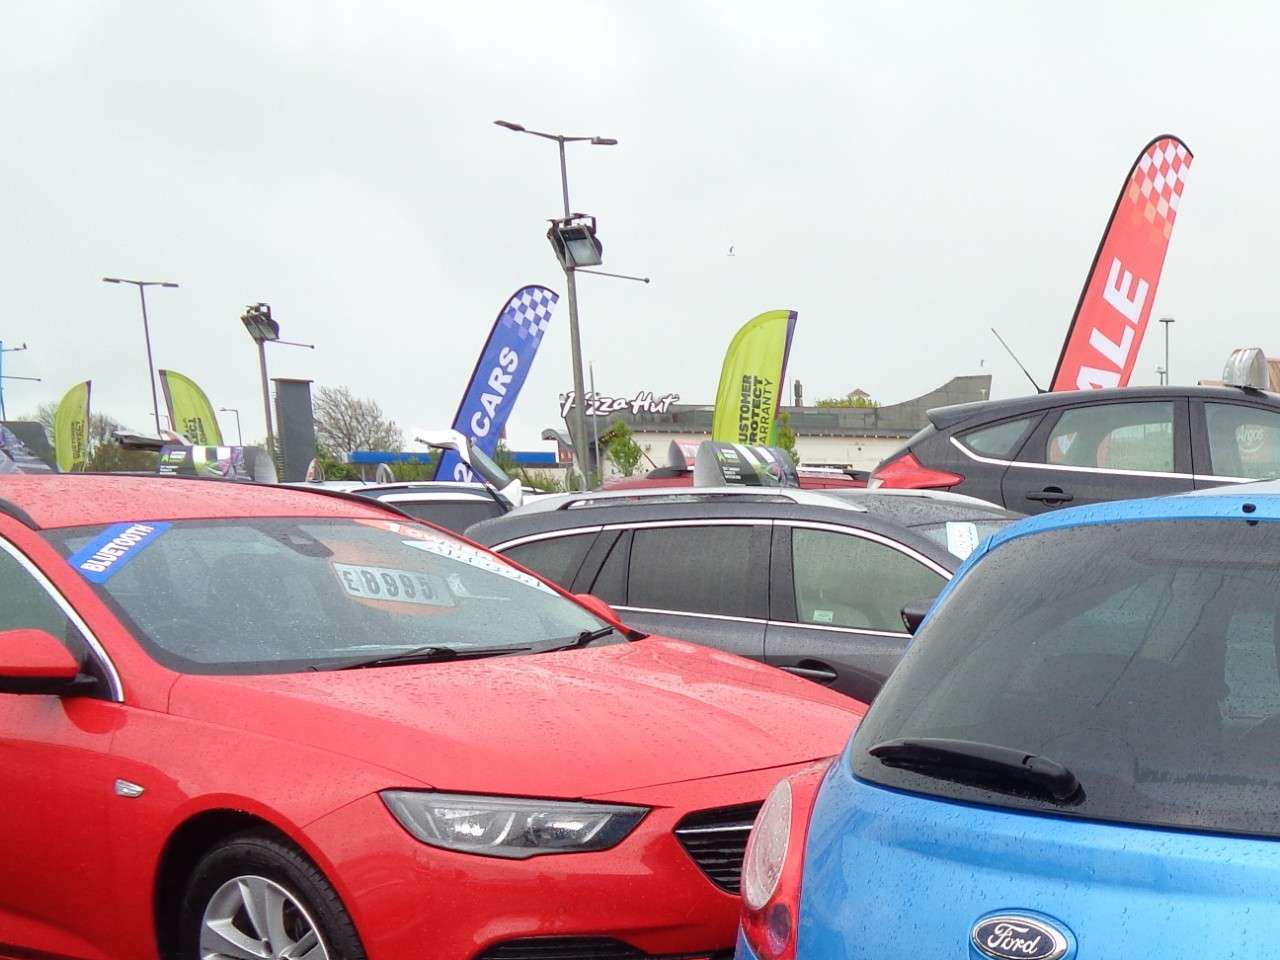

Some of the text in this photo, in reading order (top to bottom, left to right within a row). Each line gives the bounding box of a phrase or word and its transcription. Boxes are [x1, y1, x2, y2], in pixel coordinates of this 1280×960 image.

[1076, 256, 1150, 391] ALE
[470, 346, 519, 438] CARS
[630, 391, 680, 415] Hut
[738, 374, 752, 442] USTOMER
[749, 375, 763, 444] ROTECT
[758, 378, 773, 447] ARRANTY
[79, 523, 156, 573] BLUETOOTH
[987, 923, 1041, 955] Ford
